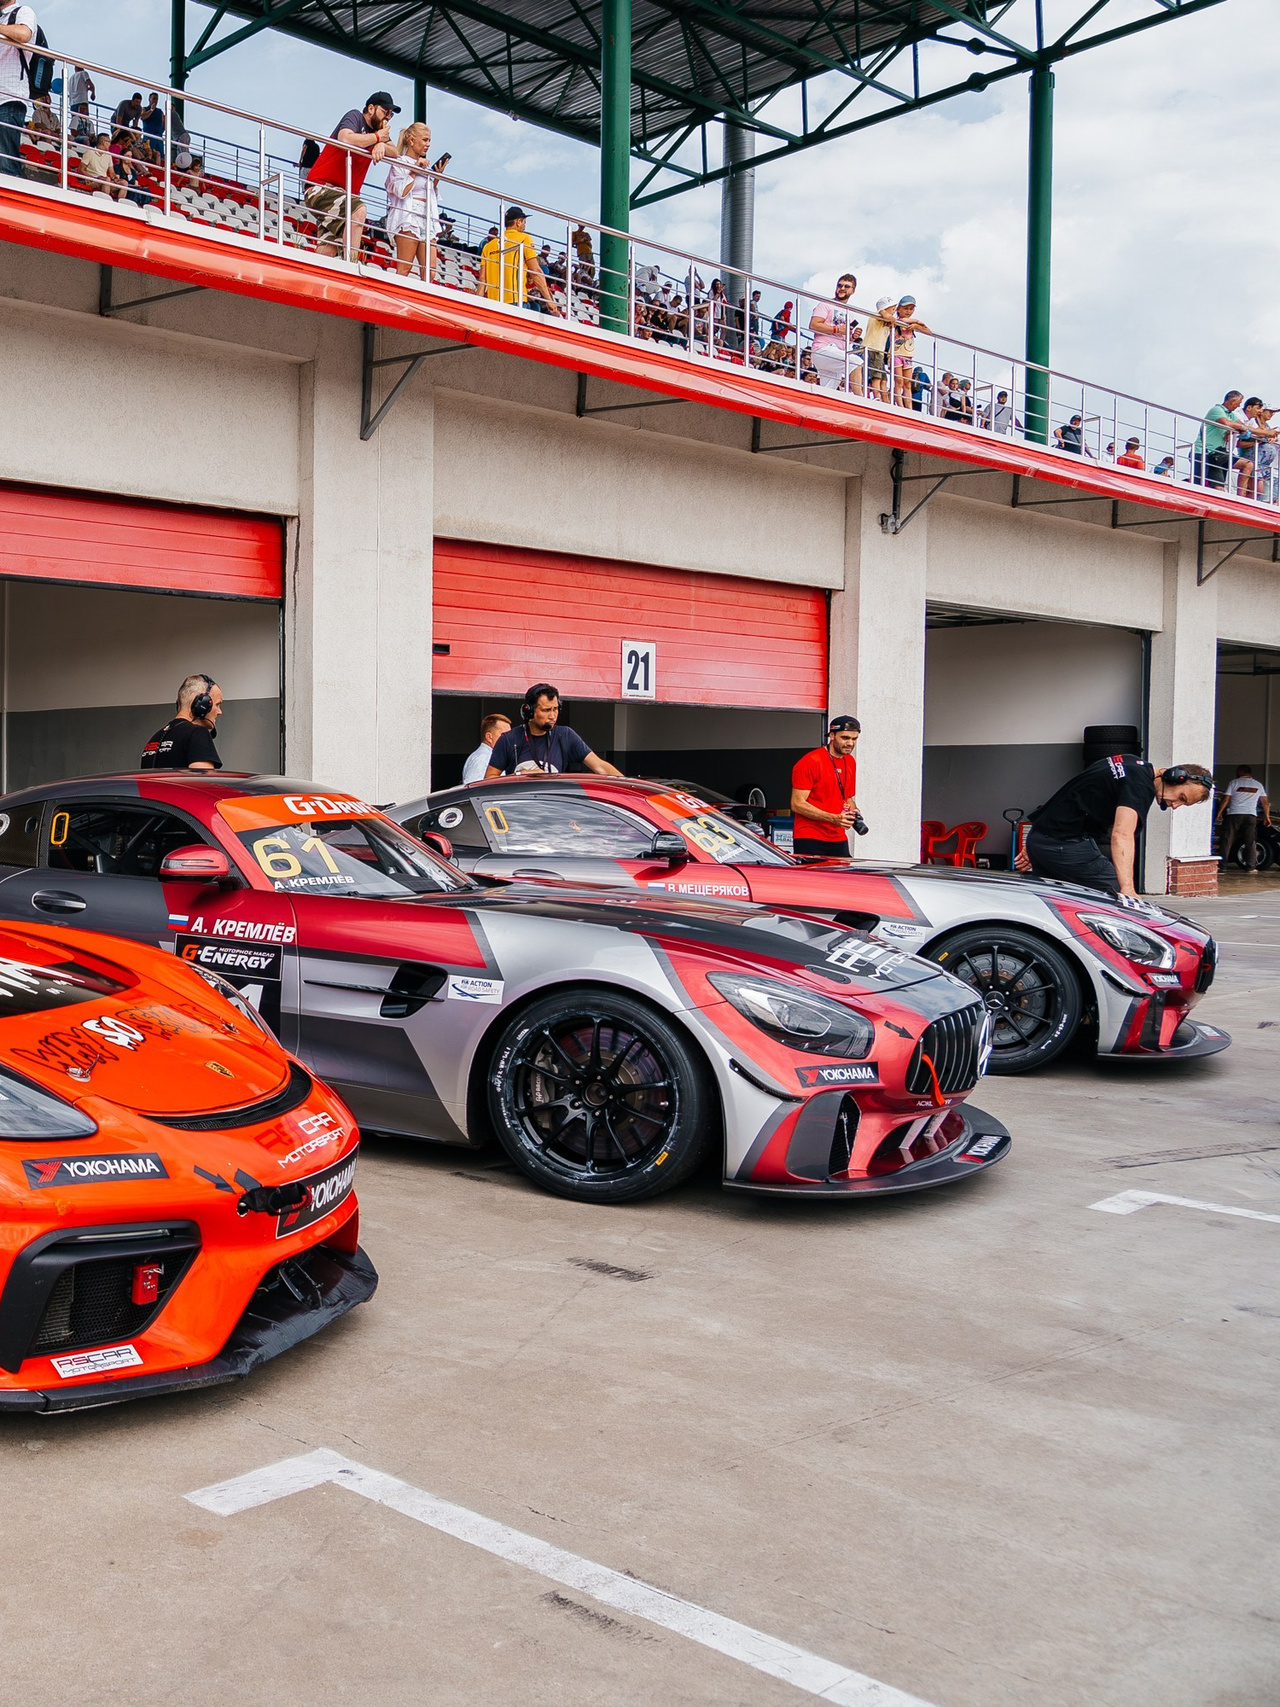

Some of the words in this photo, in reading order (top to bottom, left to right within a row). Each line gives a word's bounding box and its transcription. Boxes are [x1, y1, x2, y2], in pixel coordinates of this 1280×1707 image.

[627, 649, 650, 691] 21
[680, 816, 736, 854] 63
[252, 836, 341, 879] 61
[289, 874, 356, 889] КРЕМЛЁВ
[212, 918, 297, 943] КРЕМЛЁВ
[470, 980, 493, 988] ACTION
[819, 1066, 875, 1082] YOKOHAMA
[277, 1126, 346, 1169] MOTORSPORT
[63, 1157, 161, 1178] YOKOHAMA
[56, 1347, 133, 1369] RSCAR
[62, 1357, 136, 1375] MOTORSPORT
